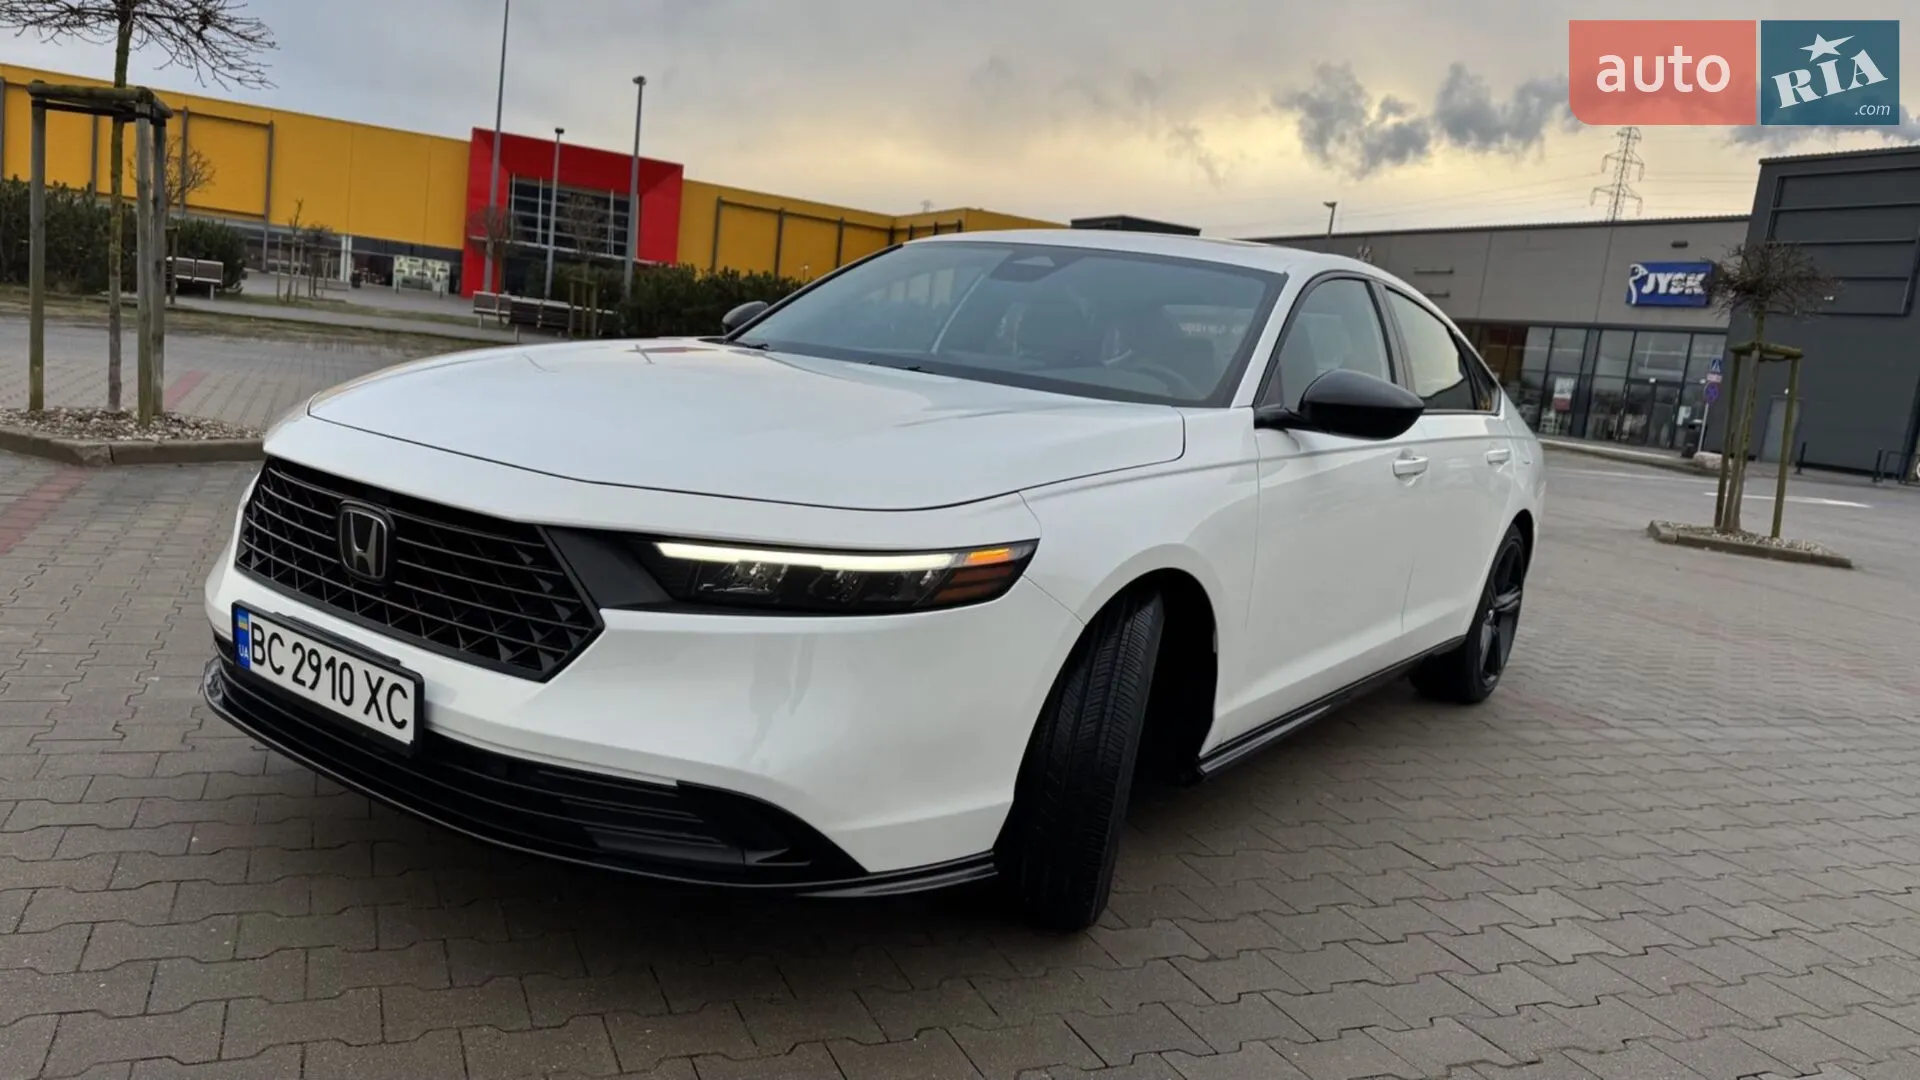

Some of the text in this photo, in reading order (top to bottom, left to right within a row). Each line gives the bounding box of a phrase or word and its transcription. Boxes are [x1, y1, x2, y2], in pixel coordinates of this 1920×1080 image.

[1641, 272, 1706, 294] JYSK
[238, 644, 249, 658] UA
[251, 621, 408, 730] BC 2910 XC
